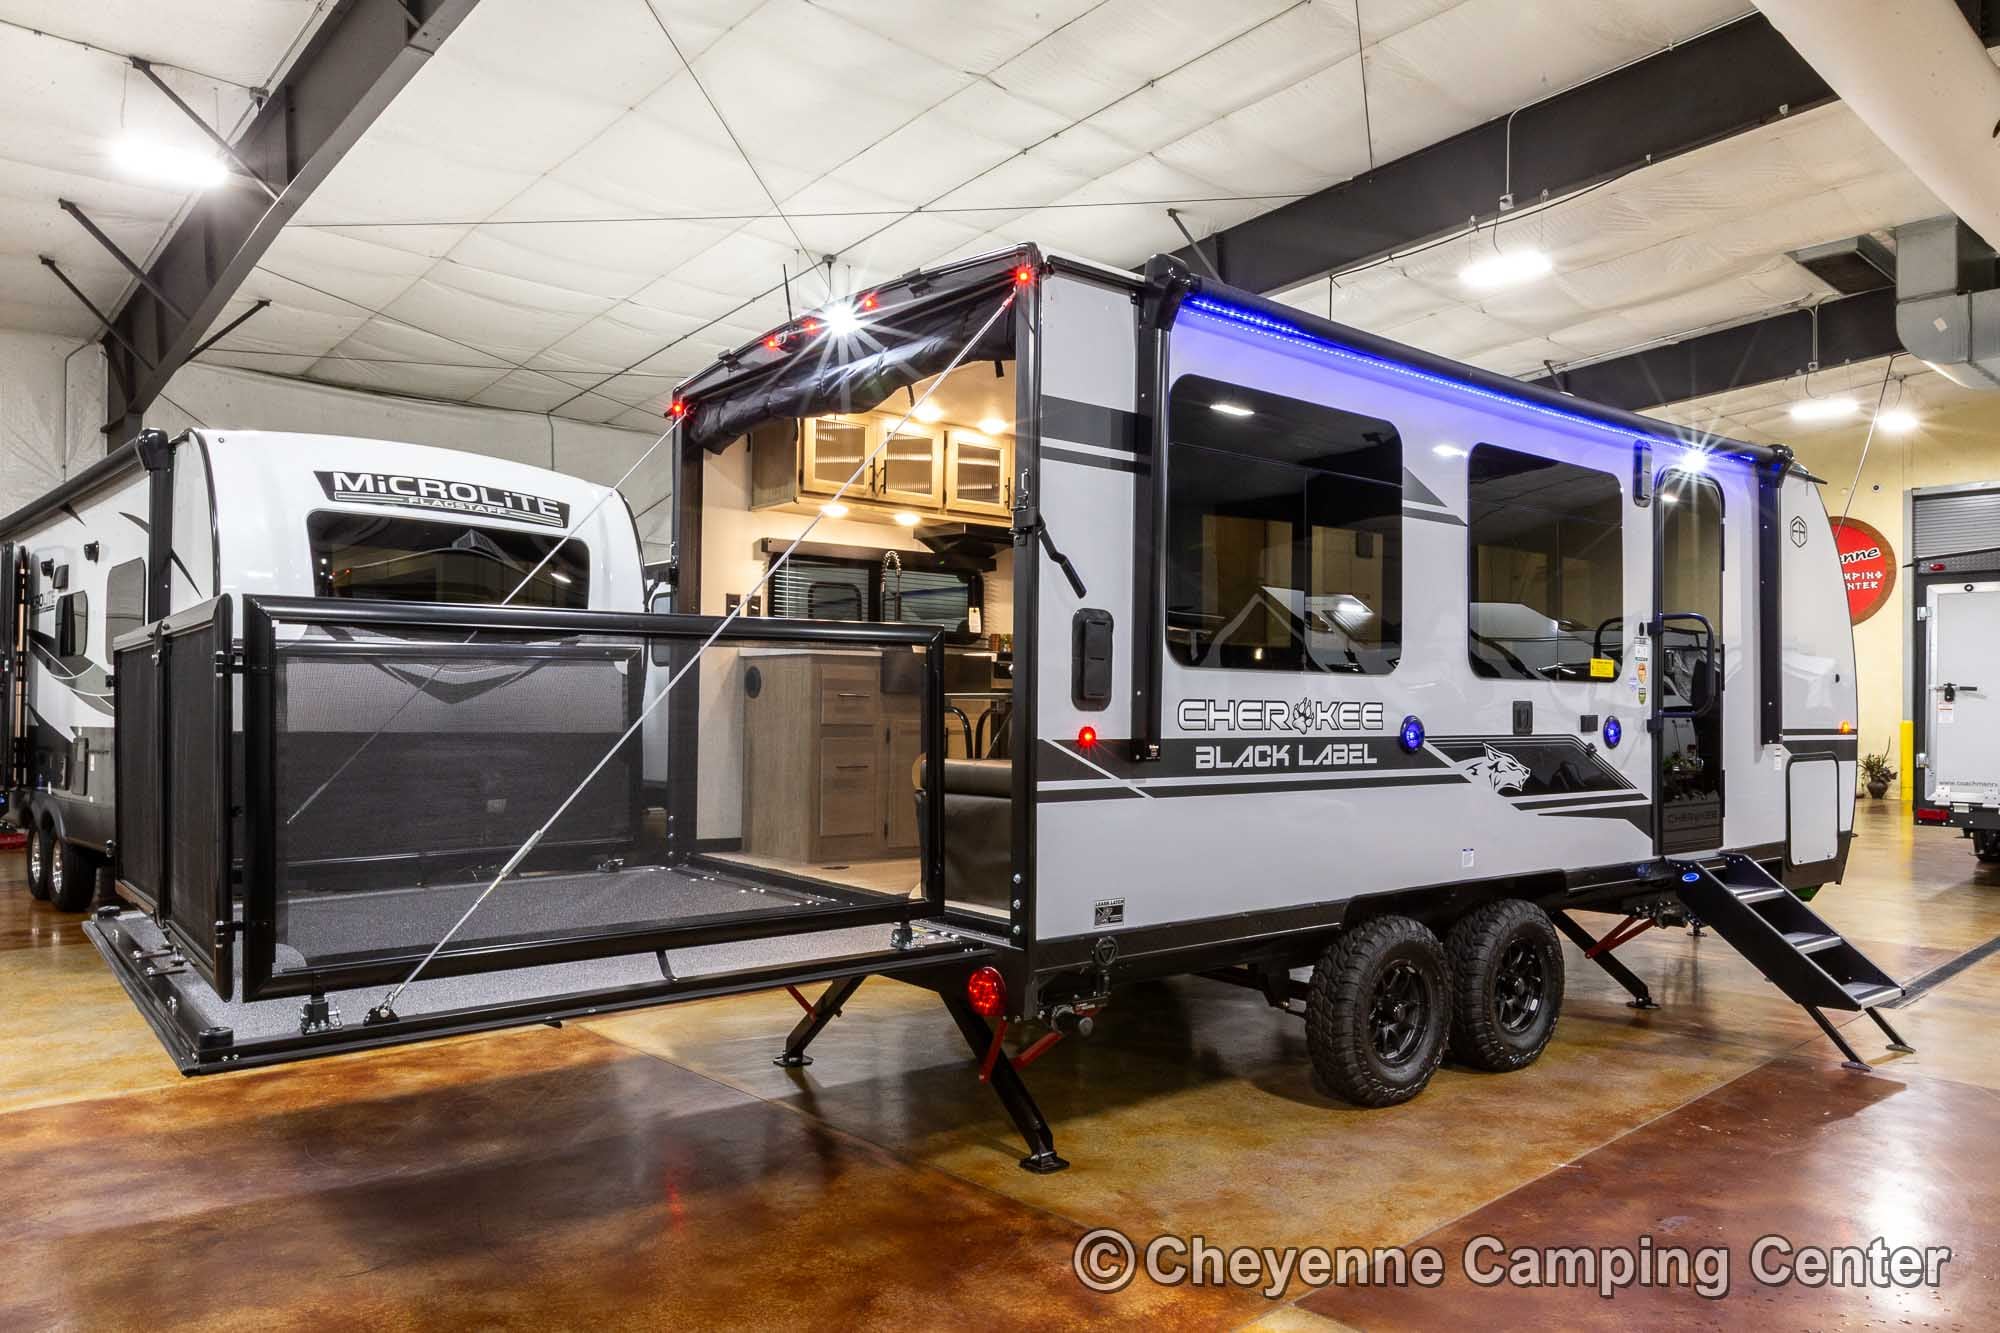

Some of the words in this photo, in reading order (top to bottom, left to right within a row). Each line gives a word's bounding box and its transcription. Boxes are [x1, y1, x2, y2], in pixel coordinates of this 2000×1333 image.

[408, 496, 507, 515] FLAGSTAFF
[1177, 698, 1384, 733] CHEROKEE
[1195, 745, 1290, 769] BLACK
[1298, 743, 1378, 767] LABEL
